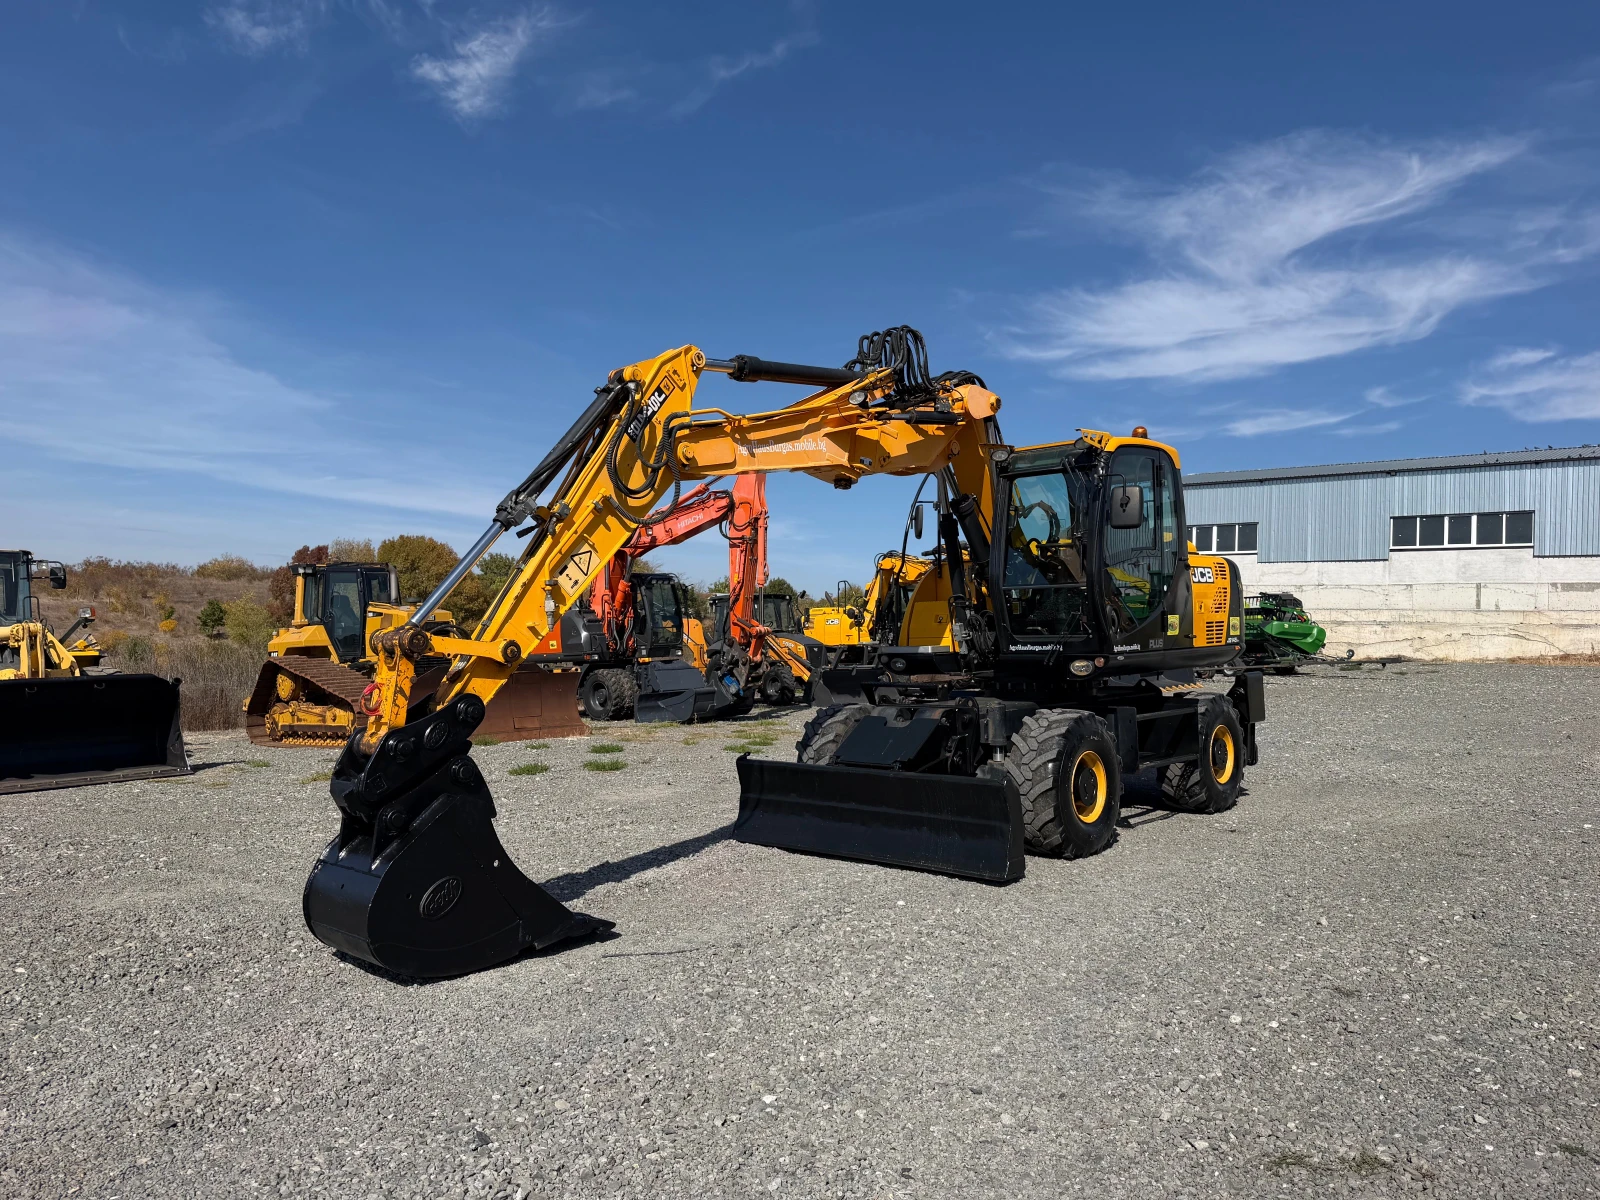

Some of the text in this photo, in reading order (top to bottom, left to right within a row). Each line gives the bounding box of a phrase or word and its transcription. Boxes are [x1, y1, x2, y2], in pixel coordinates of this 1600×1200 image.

[677, 513, 704, 529] HITACHI
[1192, 567, 1214, 582] JCB
[1149, 639, 1164, 649] PLUS
